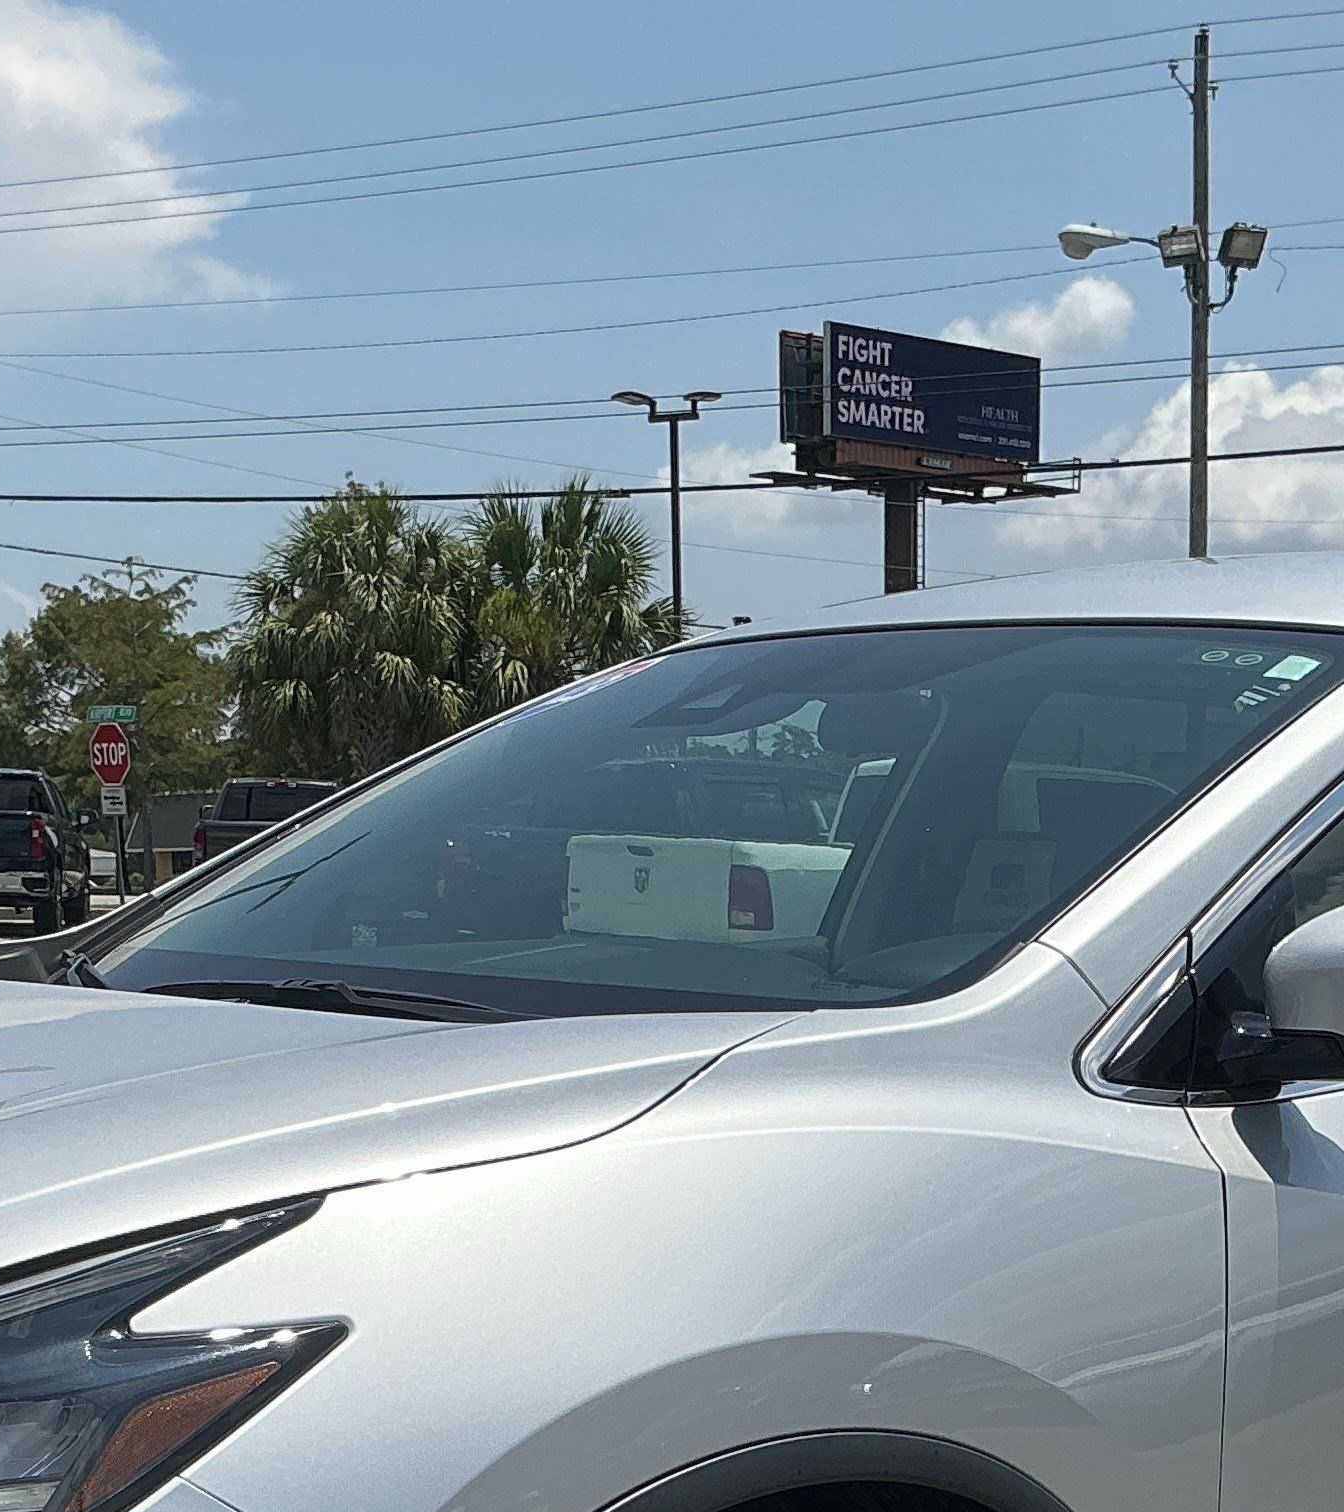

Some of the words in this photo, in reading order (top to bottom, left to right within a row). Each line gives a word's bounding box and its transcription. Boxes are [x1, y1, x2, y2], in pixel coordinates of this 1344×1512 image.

[837, 334, 893, 367] FIGHT
[837, 366, 913, 402] CANCER
[837, 398, 926, 435] SMARTER
[93, 742, 126, 766] STOP
